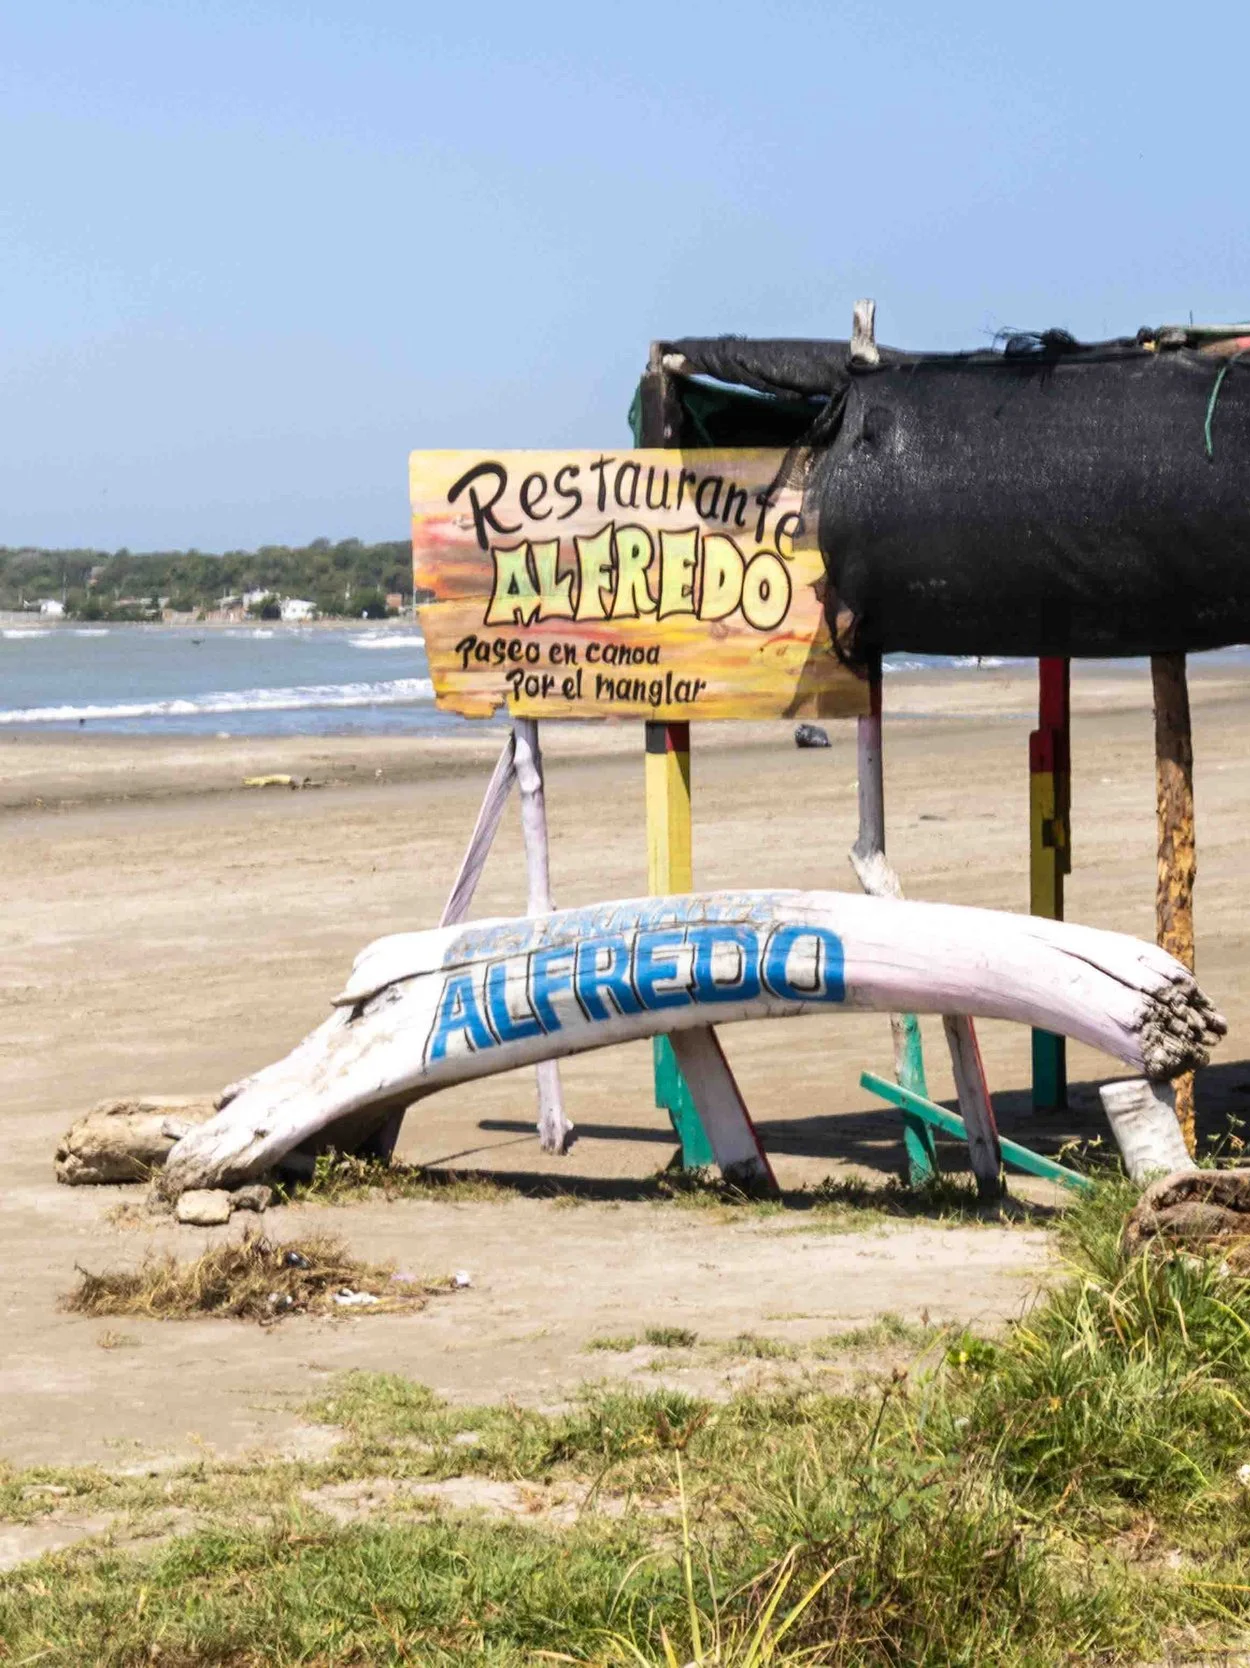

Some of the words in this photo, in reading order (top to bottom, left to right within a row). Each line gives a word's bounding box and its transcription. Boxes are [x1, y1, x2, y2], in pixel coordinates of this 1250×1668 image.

[447, 453, 806, 561] Restaurante
[484, 520, 792, 631] ALFREDO
[454, 633, 541, 670] Paseo
[548, 641, 579, 666] en
[585, 641, 661, 666] canoa
[505, 667, 555, 702] Por
[561, 667, 583, 700] el
[422, 923, 847, 1072] ALFREDO
